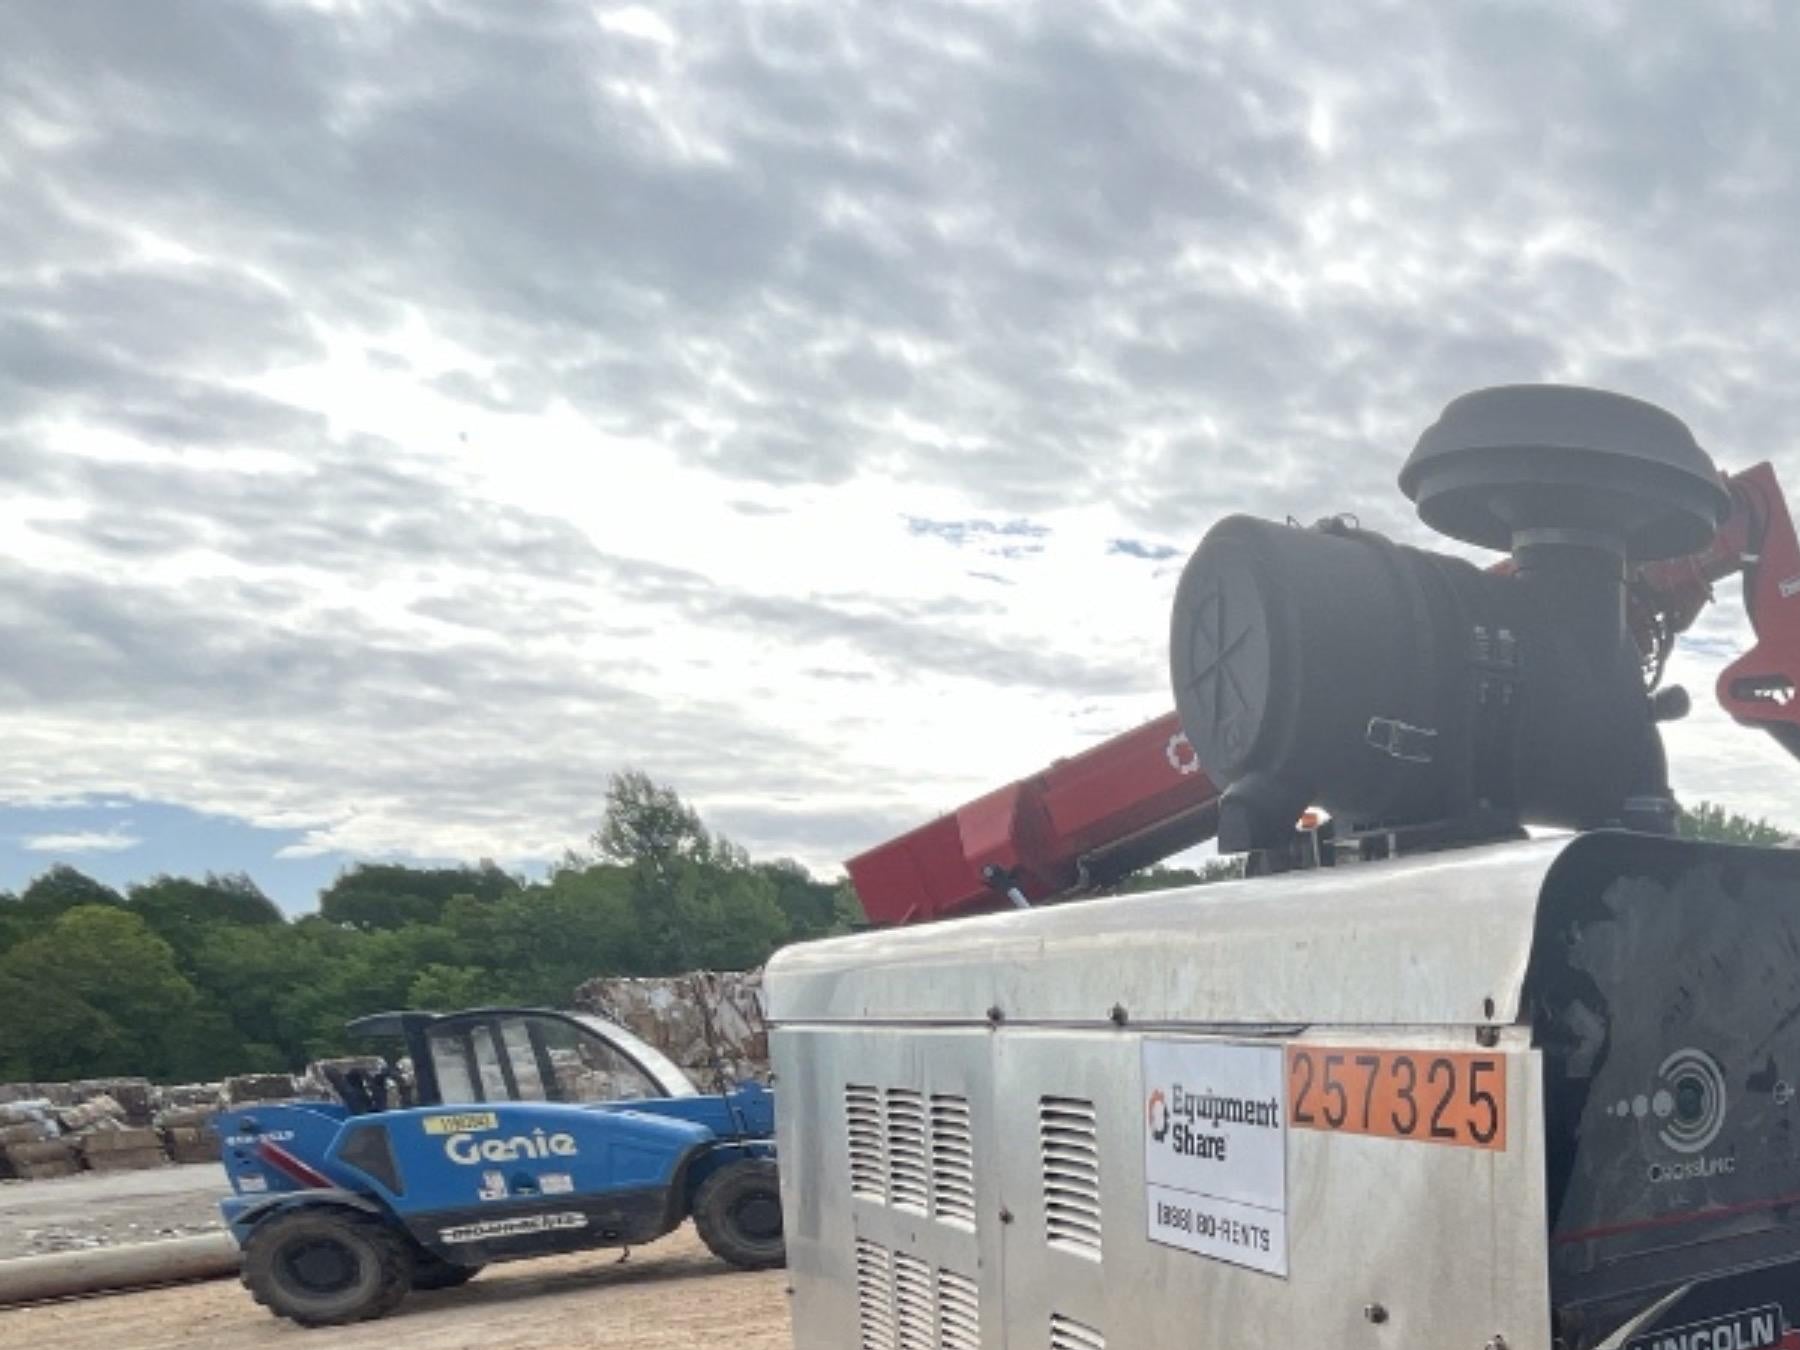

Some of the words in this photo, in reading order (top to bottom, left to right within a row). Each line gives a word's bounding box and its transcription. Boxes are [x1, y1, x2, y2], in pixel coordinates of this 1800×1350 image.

[1172, 1083, 1279, 1130] Equipment
[1291, 1052, 1499, 1144] 257325
[445, 1127, 577, 1165] Genie
[1172, 1123, 1227, 1162] Share
